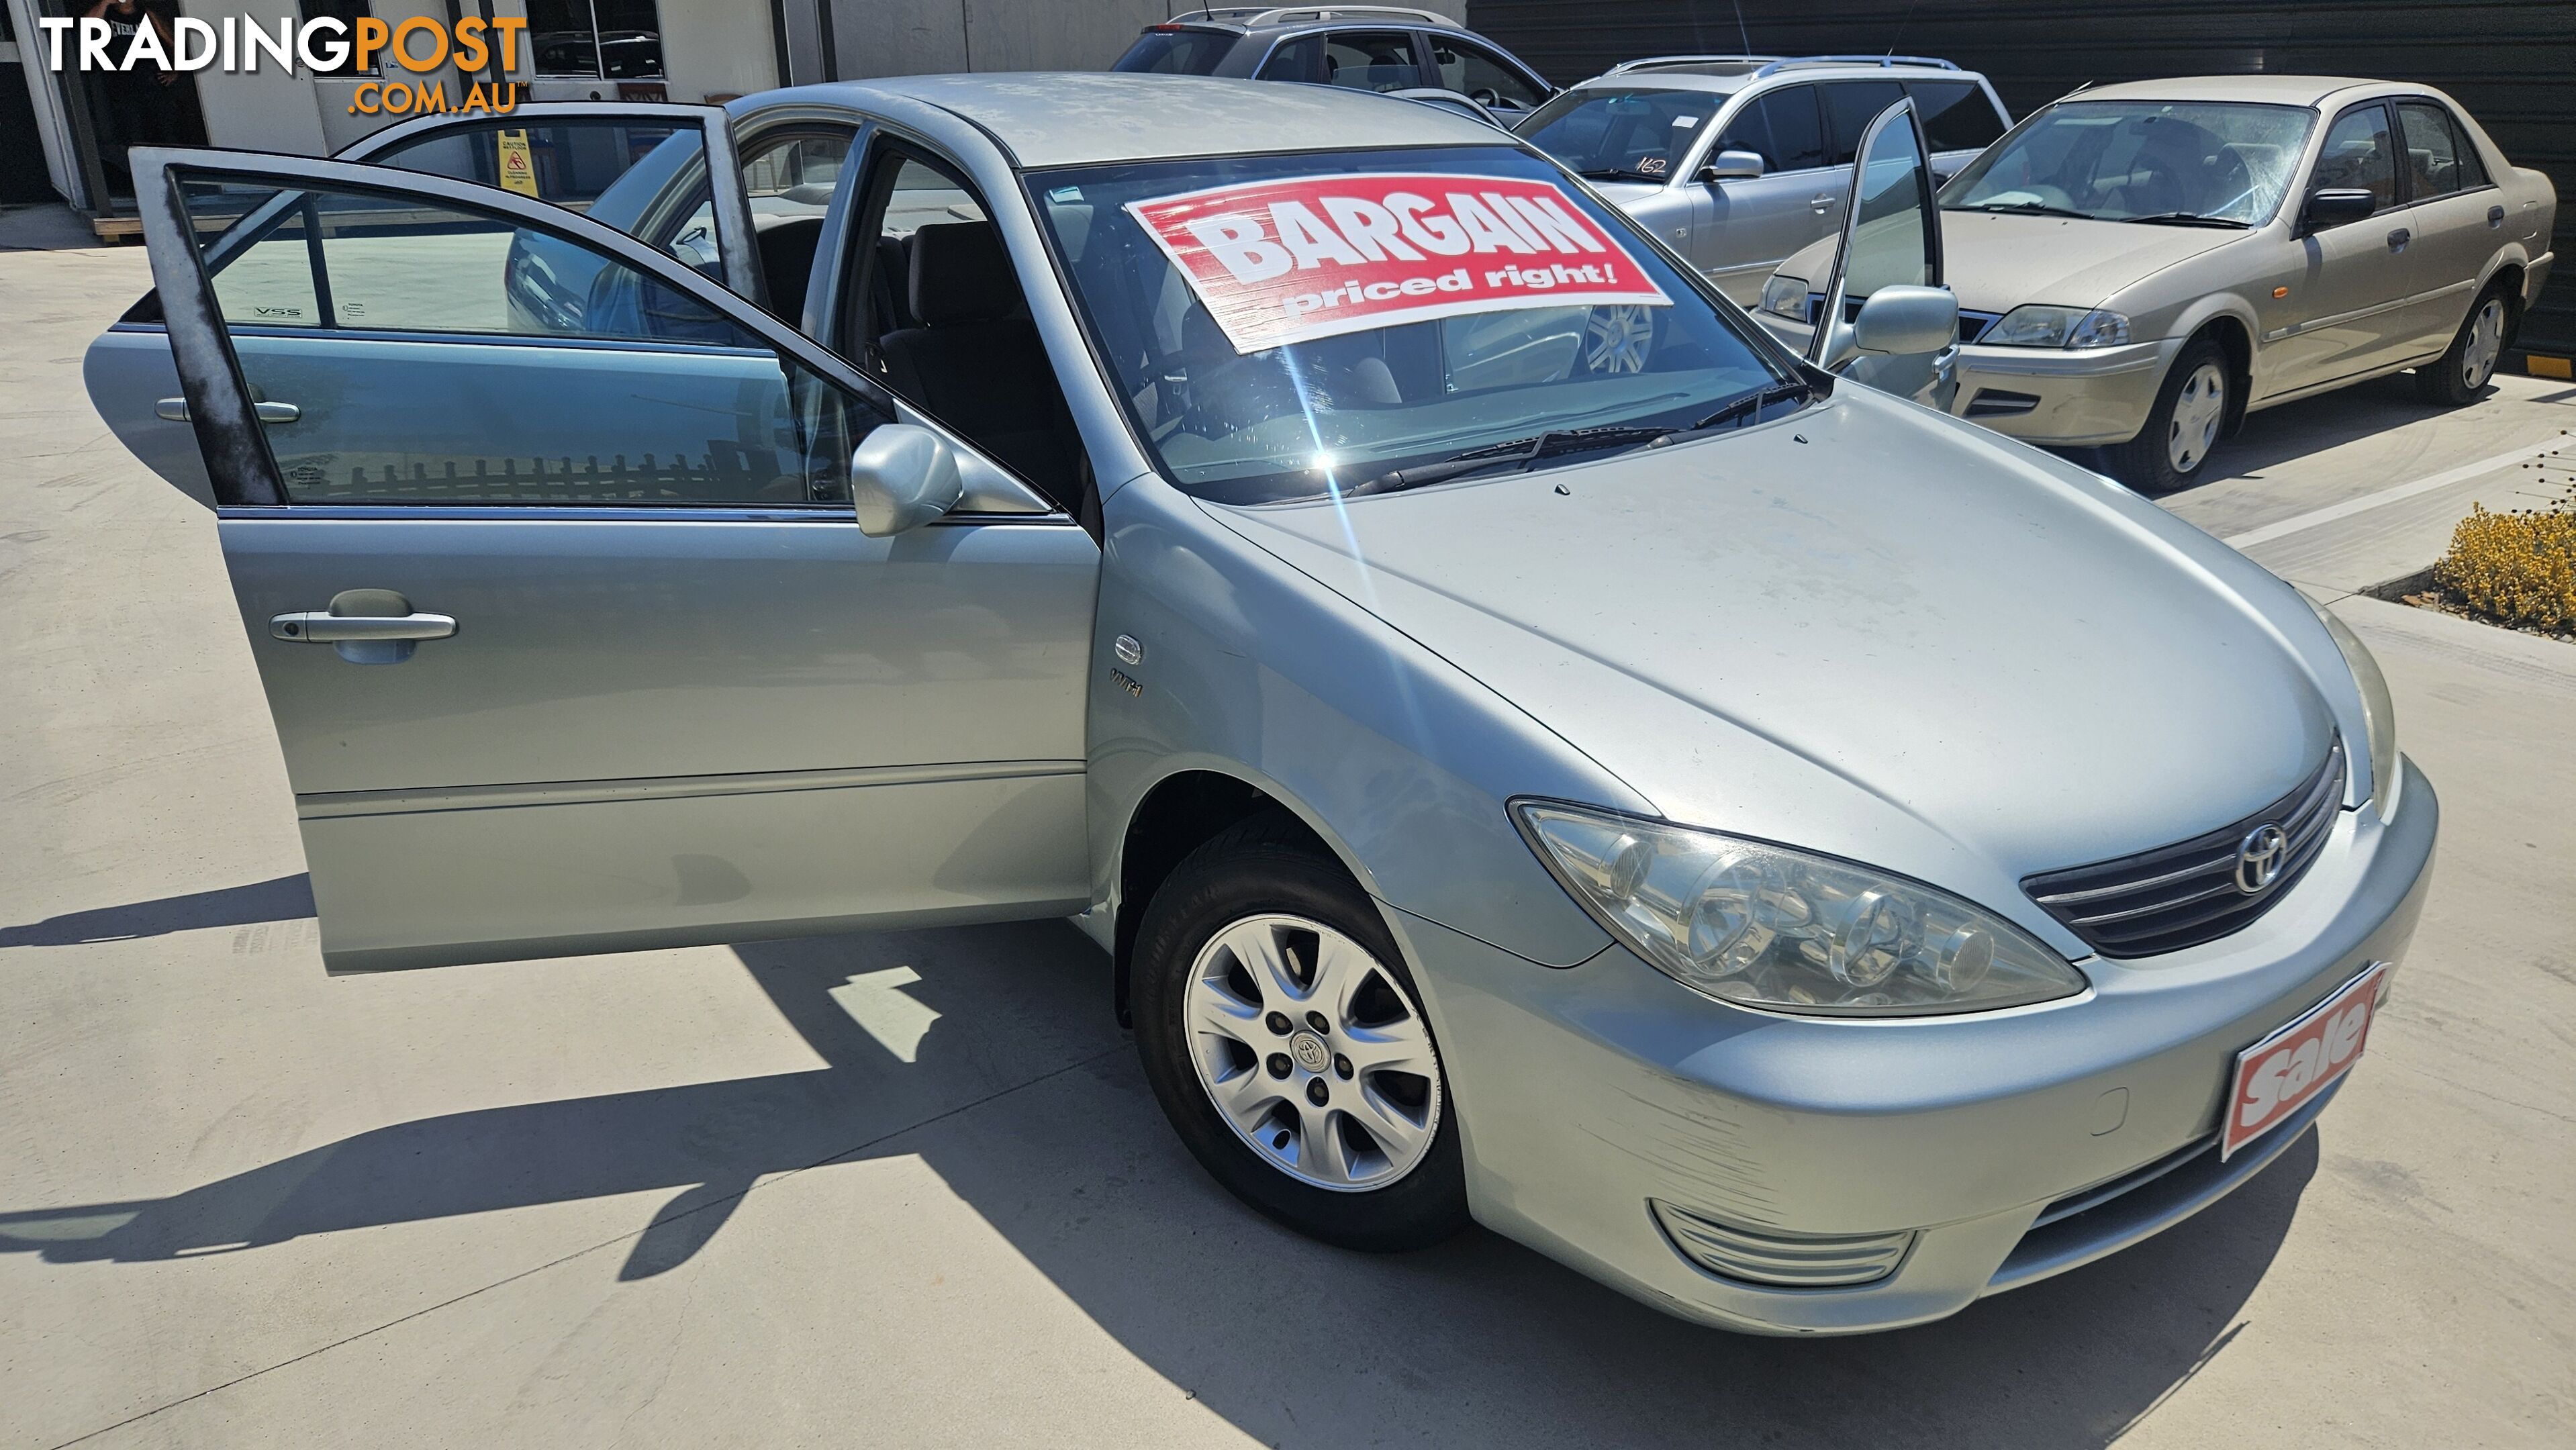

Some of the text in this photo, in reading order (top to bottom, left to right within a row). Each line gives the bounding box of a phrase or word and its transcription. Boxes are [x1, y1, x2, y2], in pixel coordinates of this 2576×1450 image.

[1635, 156, 1666, 173] 162
[1188, 192, 1606, 285] BARGAIN
[1284, 263, 1618, 321] priced right!
[2240, 1002, 2366, 1127] Sale
